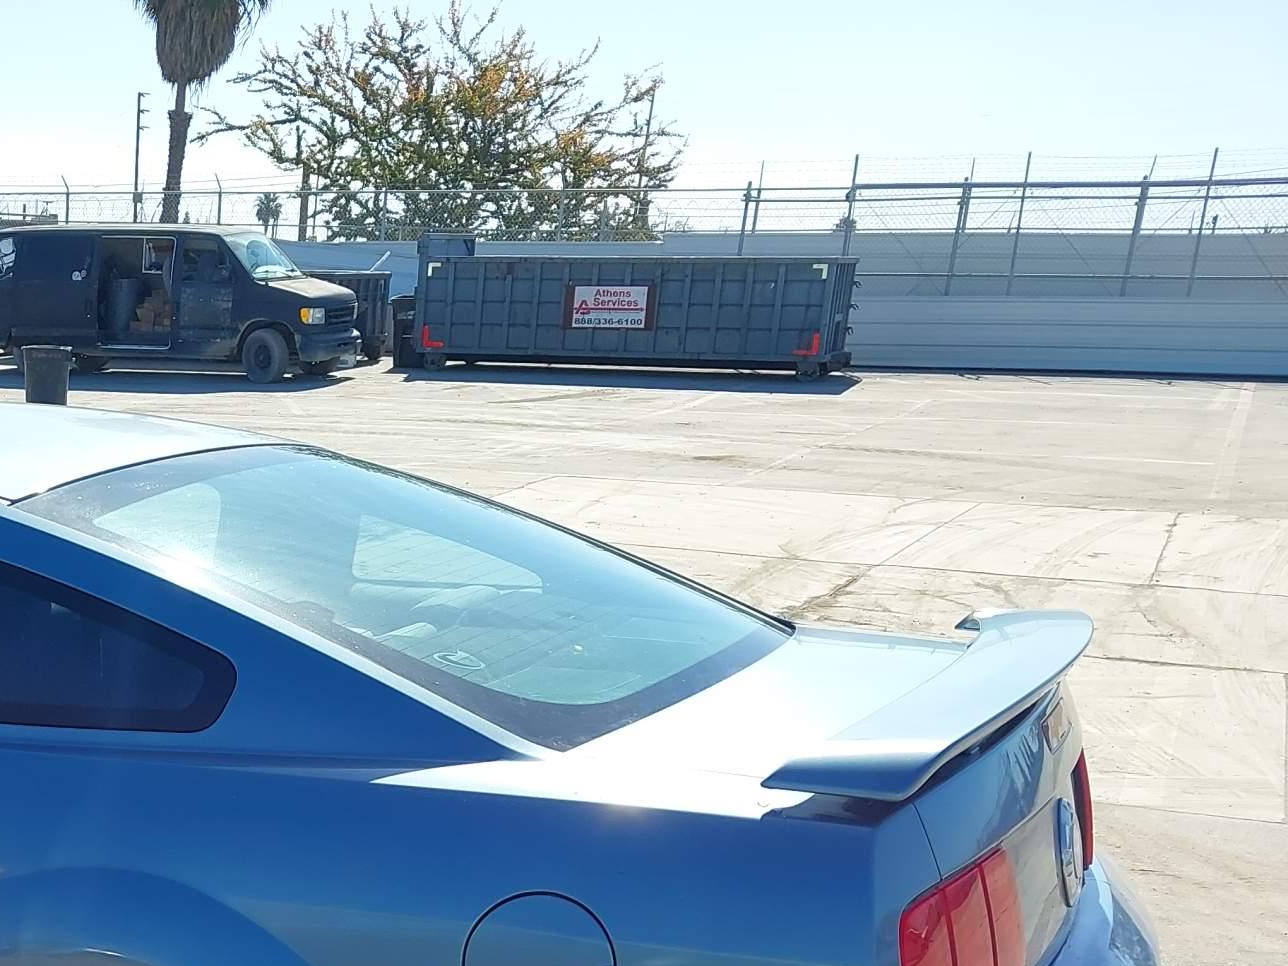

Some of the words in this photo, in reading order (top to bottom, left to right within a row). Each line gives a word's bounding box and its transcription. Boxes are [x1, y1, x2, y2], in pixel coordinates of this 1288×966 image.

[594, 288, 632, 298] Athens
[592, 298, 639, 307] Services
[573, 317, 643, 326] 888/336-6100
